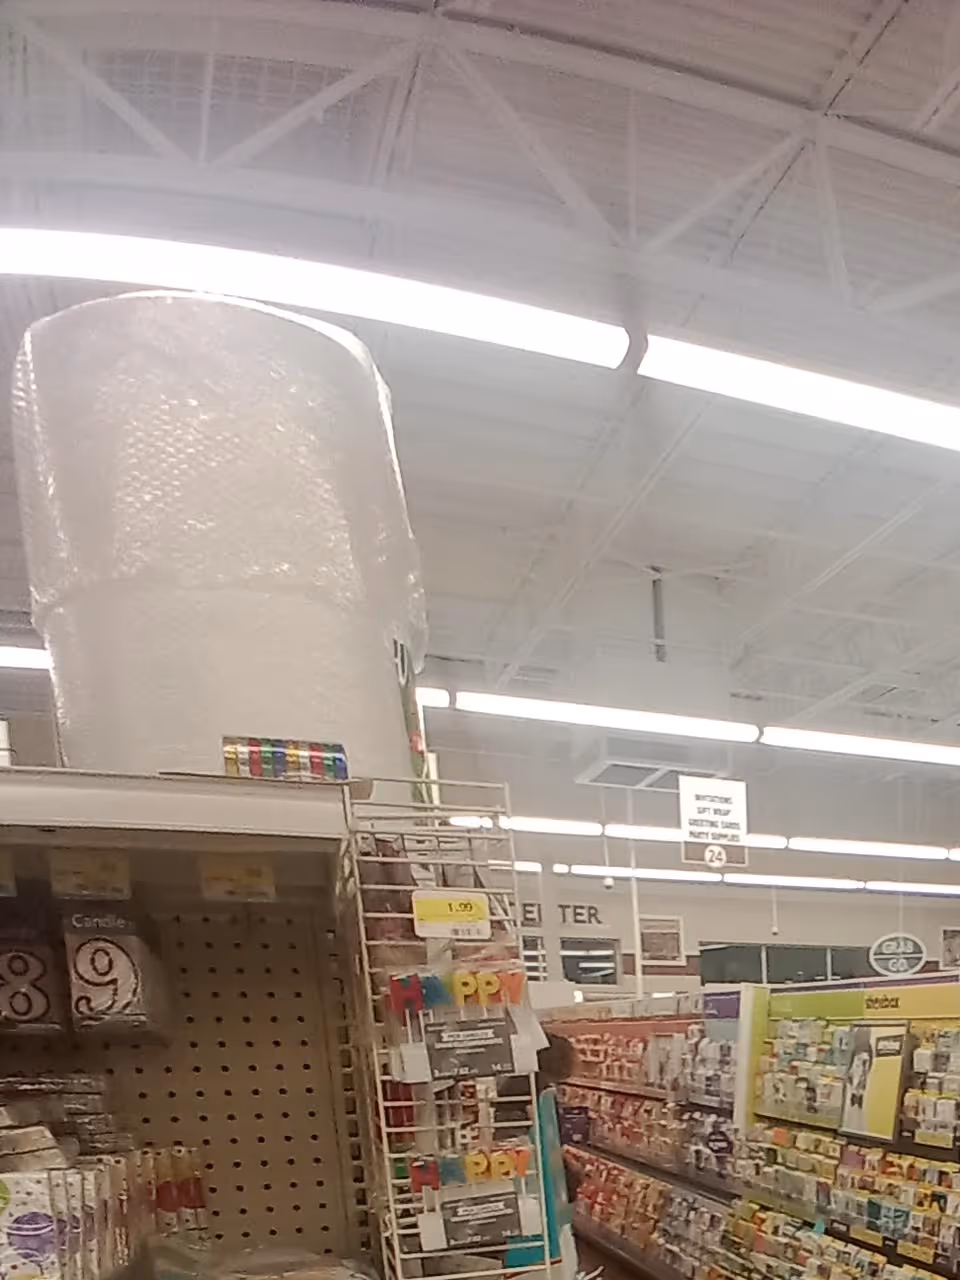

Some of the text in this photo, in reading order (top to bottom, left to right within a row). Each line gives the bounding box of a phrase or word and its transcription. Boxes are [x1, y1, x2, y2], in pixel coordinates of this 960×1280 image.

[708, 849, 724, 864] 24
[448, 902, 474, 914] 1.99
[71, 914, 127, 930] Candle
[73, 938, 140, 1018] 9
